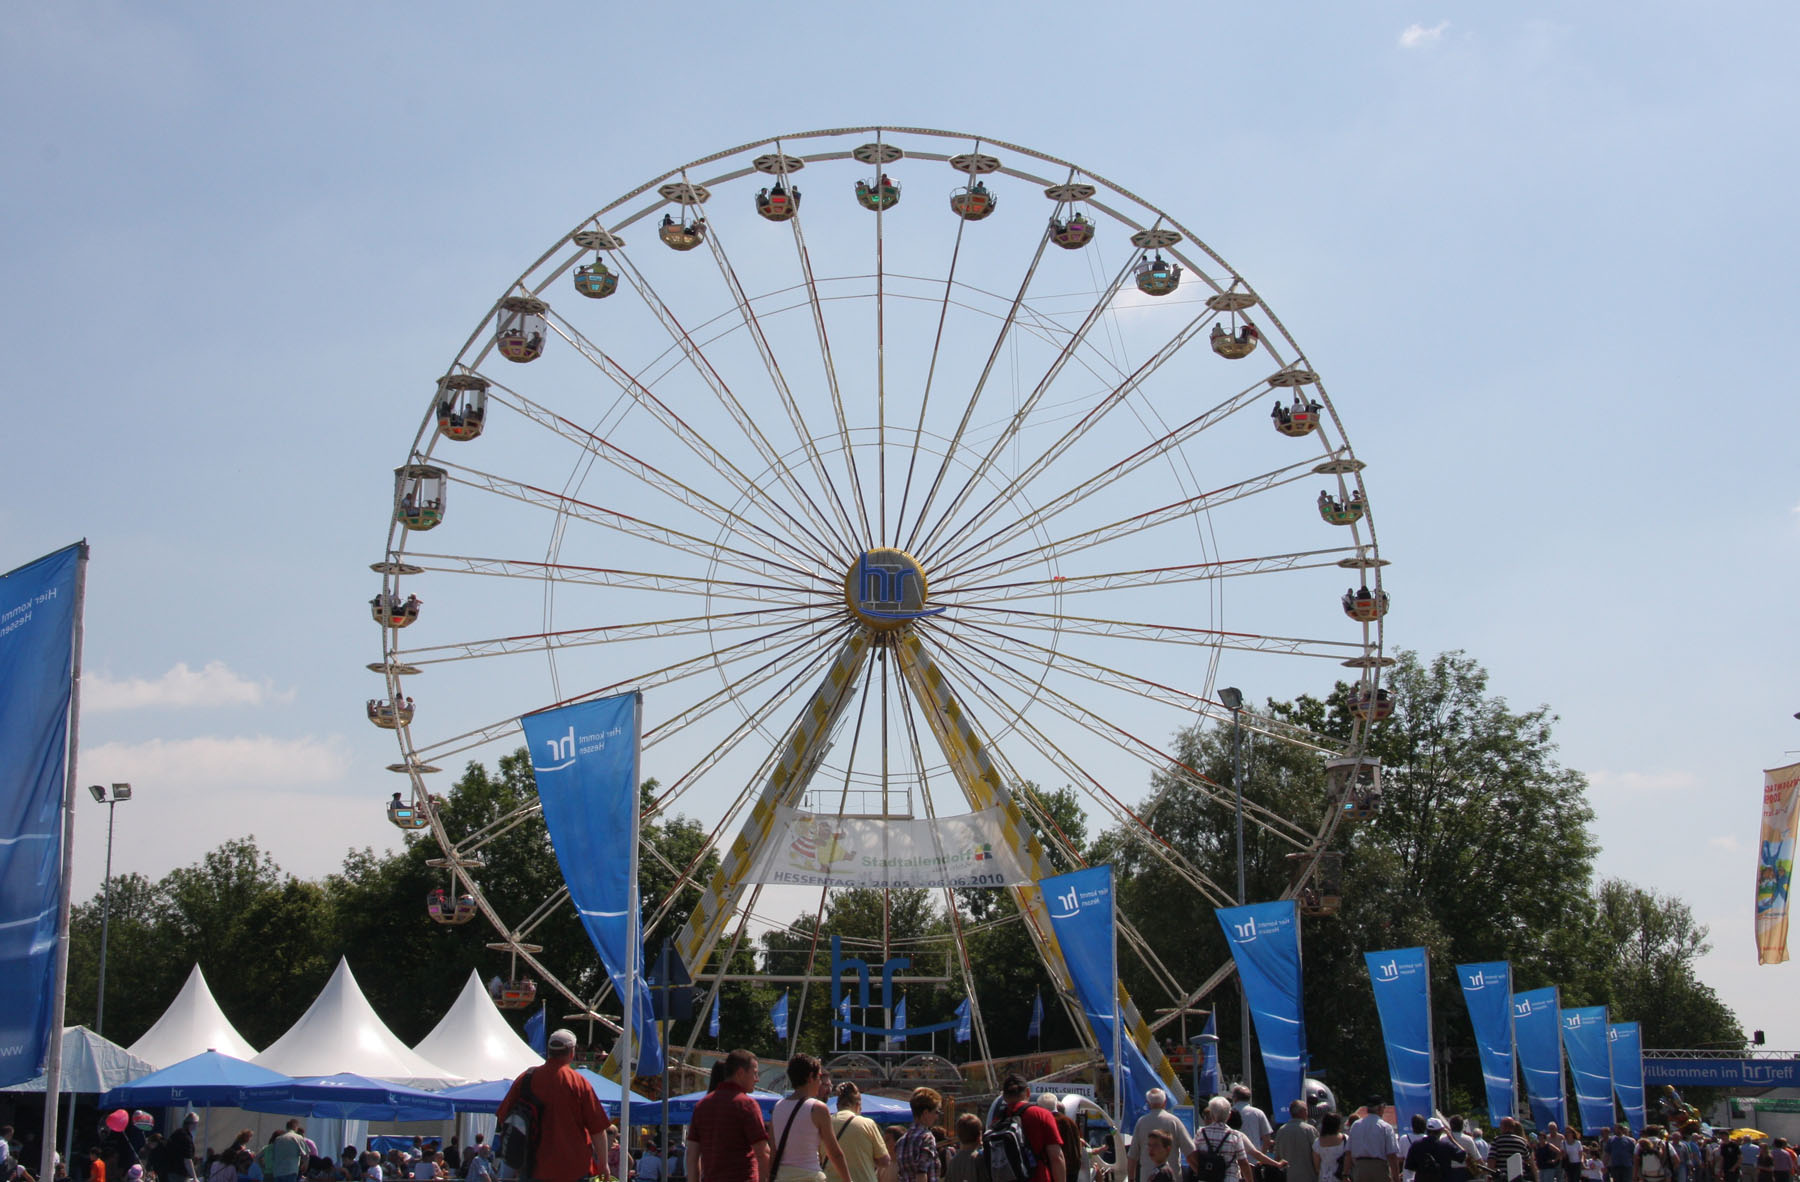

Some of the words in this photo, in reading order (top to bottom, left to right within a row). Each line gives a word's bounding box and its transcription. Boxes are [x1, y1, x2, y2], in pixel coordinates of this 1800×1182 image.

[860, 552, 915, 602] hr
[861, 850, 972, 867] Stadtallendorf
[774, 871, 855, 887] HESSENTAG
[831, 935, 911, 1008] hr
[1722, 1066, 1738, 1078] im
[1742, 1061, 1759, 1079] hr
[1765, 1066, 1793, 1079] Treff
